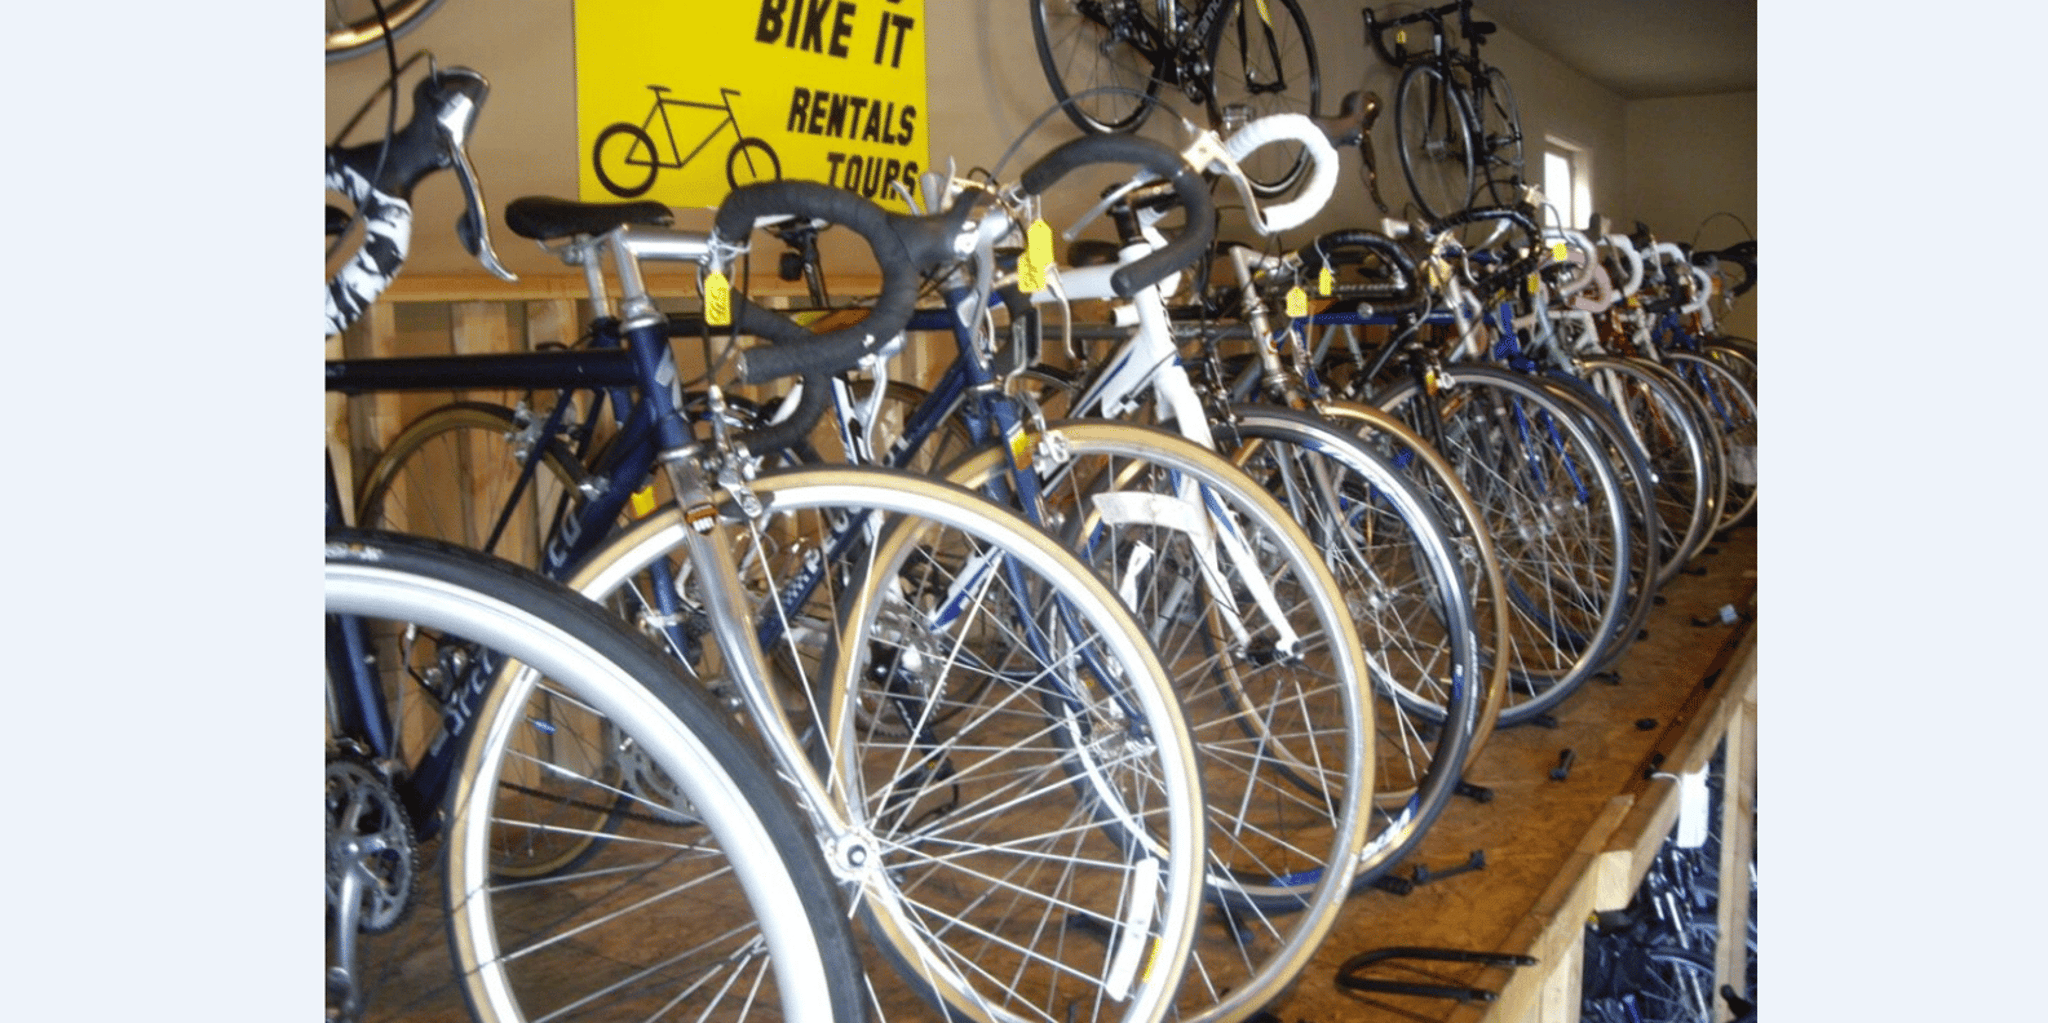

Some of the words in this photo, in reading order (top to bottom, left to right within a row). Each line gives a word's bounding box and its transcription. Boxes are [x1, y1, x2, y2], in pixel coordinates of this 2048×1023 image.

[755, 0, 857, 59] BIKE
[873, 11, 915, 69] IT
[786, 86, 917, 146] RENTALS
[827, 152, 919, 201] TOURS
